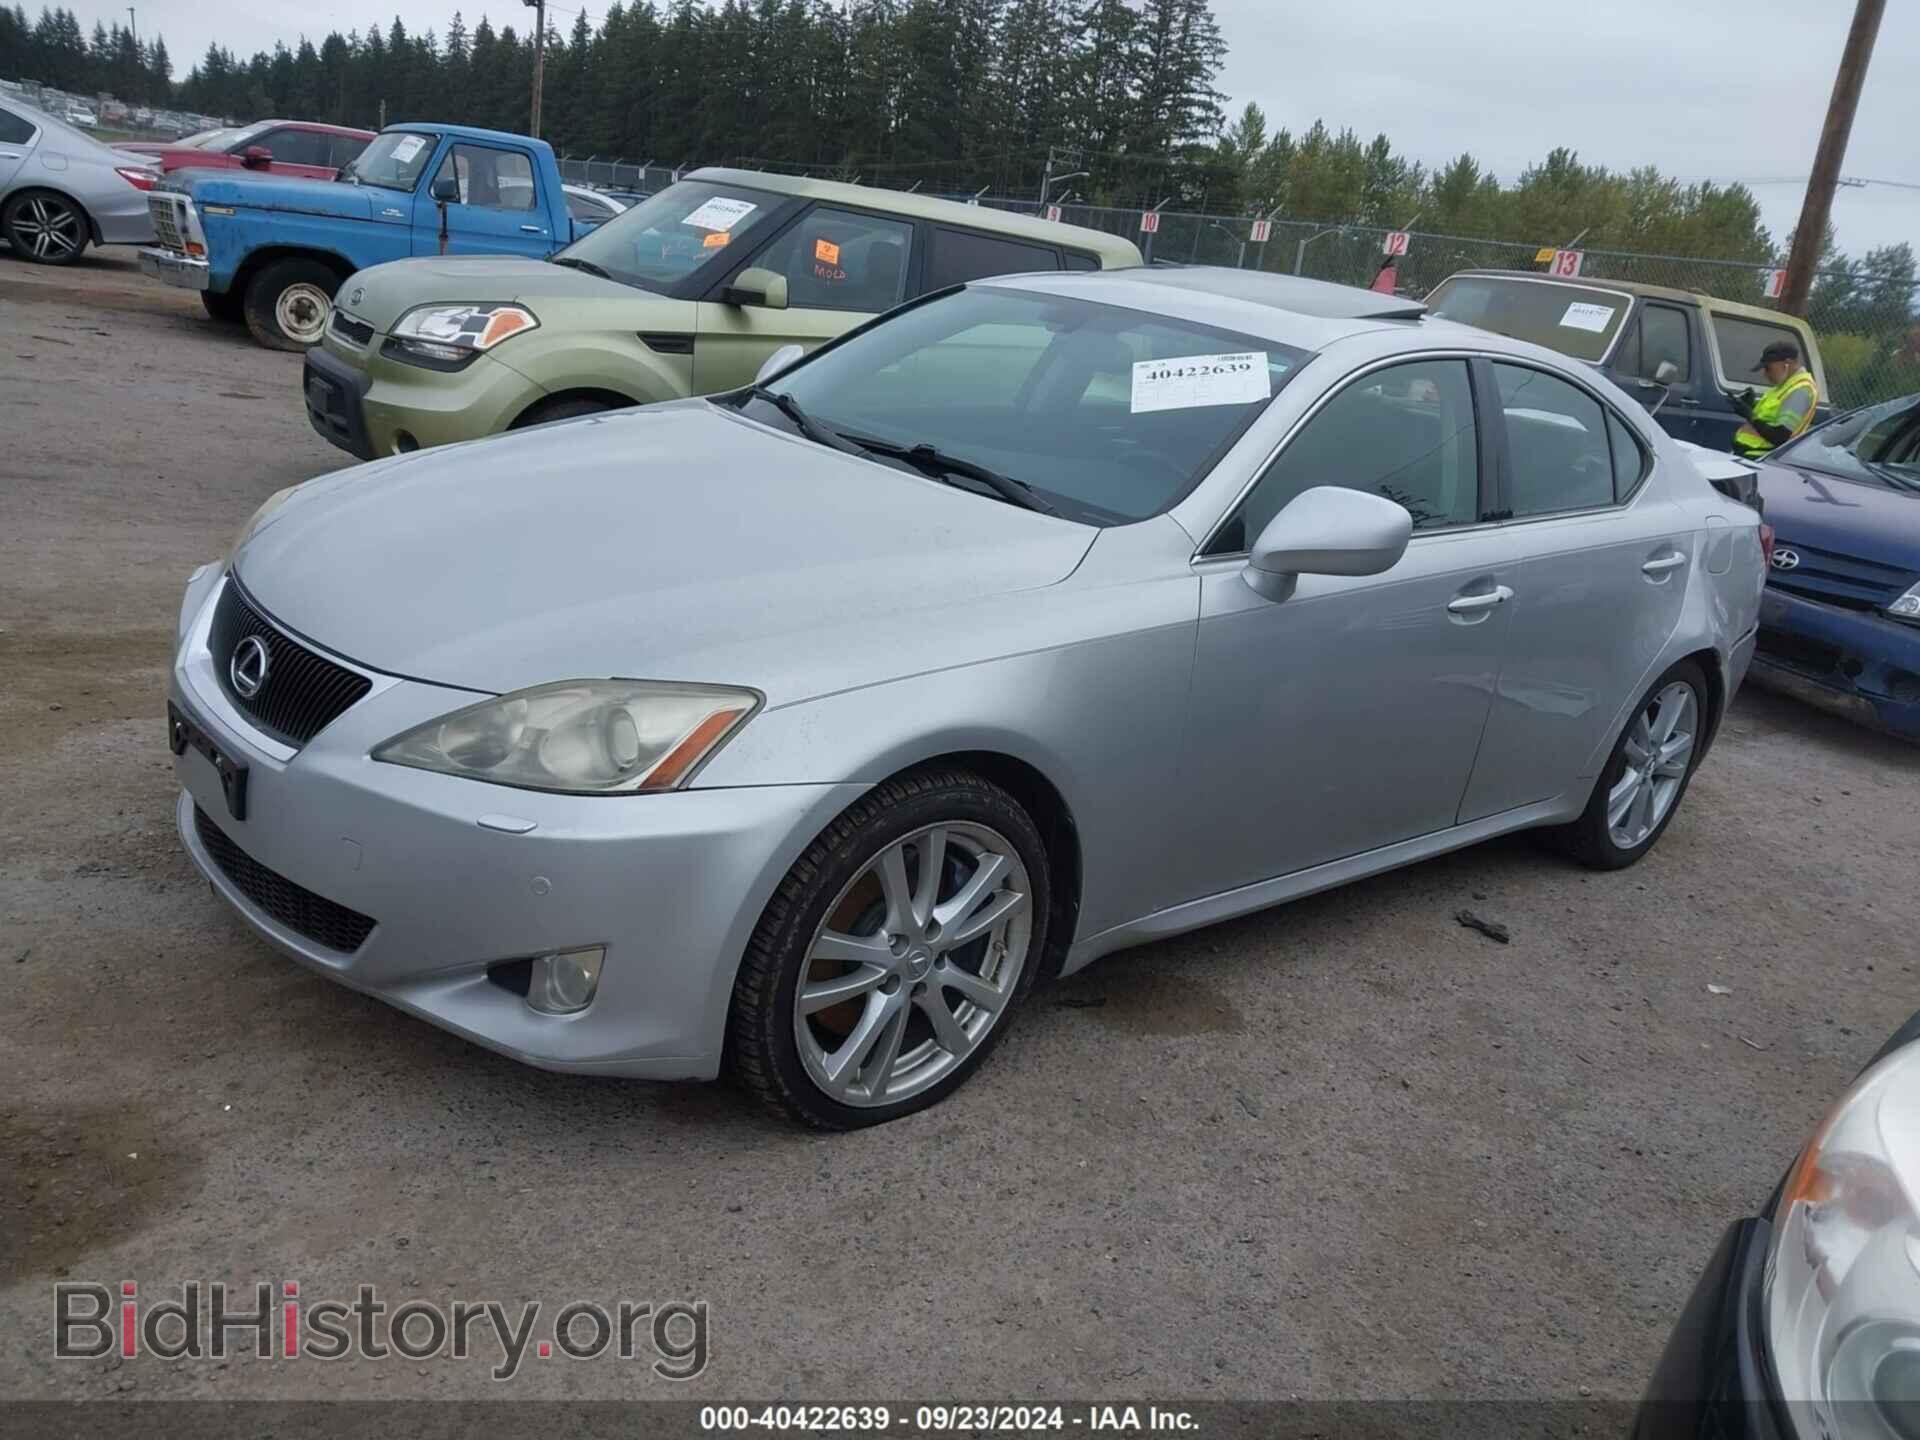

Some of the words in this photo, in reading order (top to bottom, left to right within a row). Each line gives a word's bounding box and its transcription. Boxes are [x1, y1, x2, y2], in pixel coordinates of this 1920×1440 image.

[1145, 214, 1158, 231] 10
[1256, 222, 1265, 240] 11
[1389, 234, 1405, 253] 12
[1556, 251, 1577, 275] 13
[1146, 363, 1252, 380] 40422639
